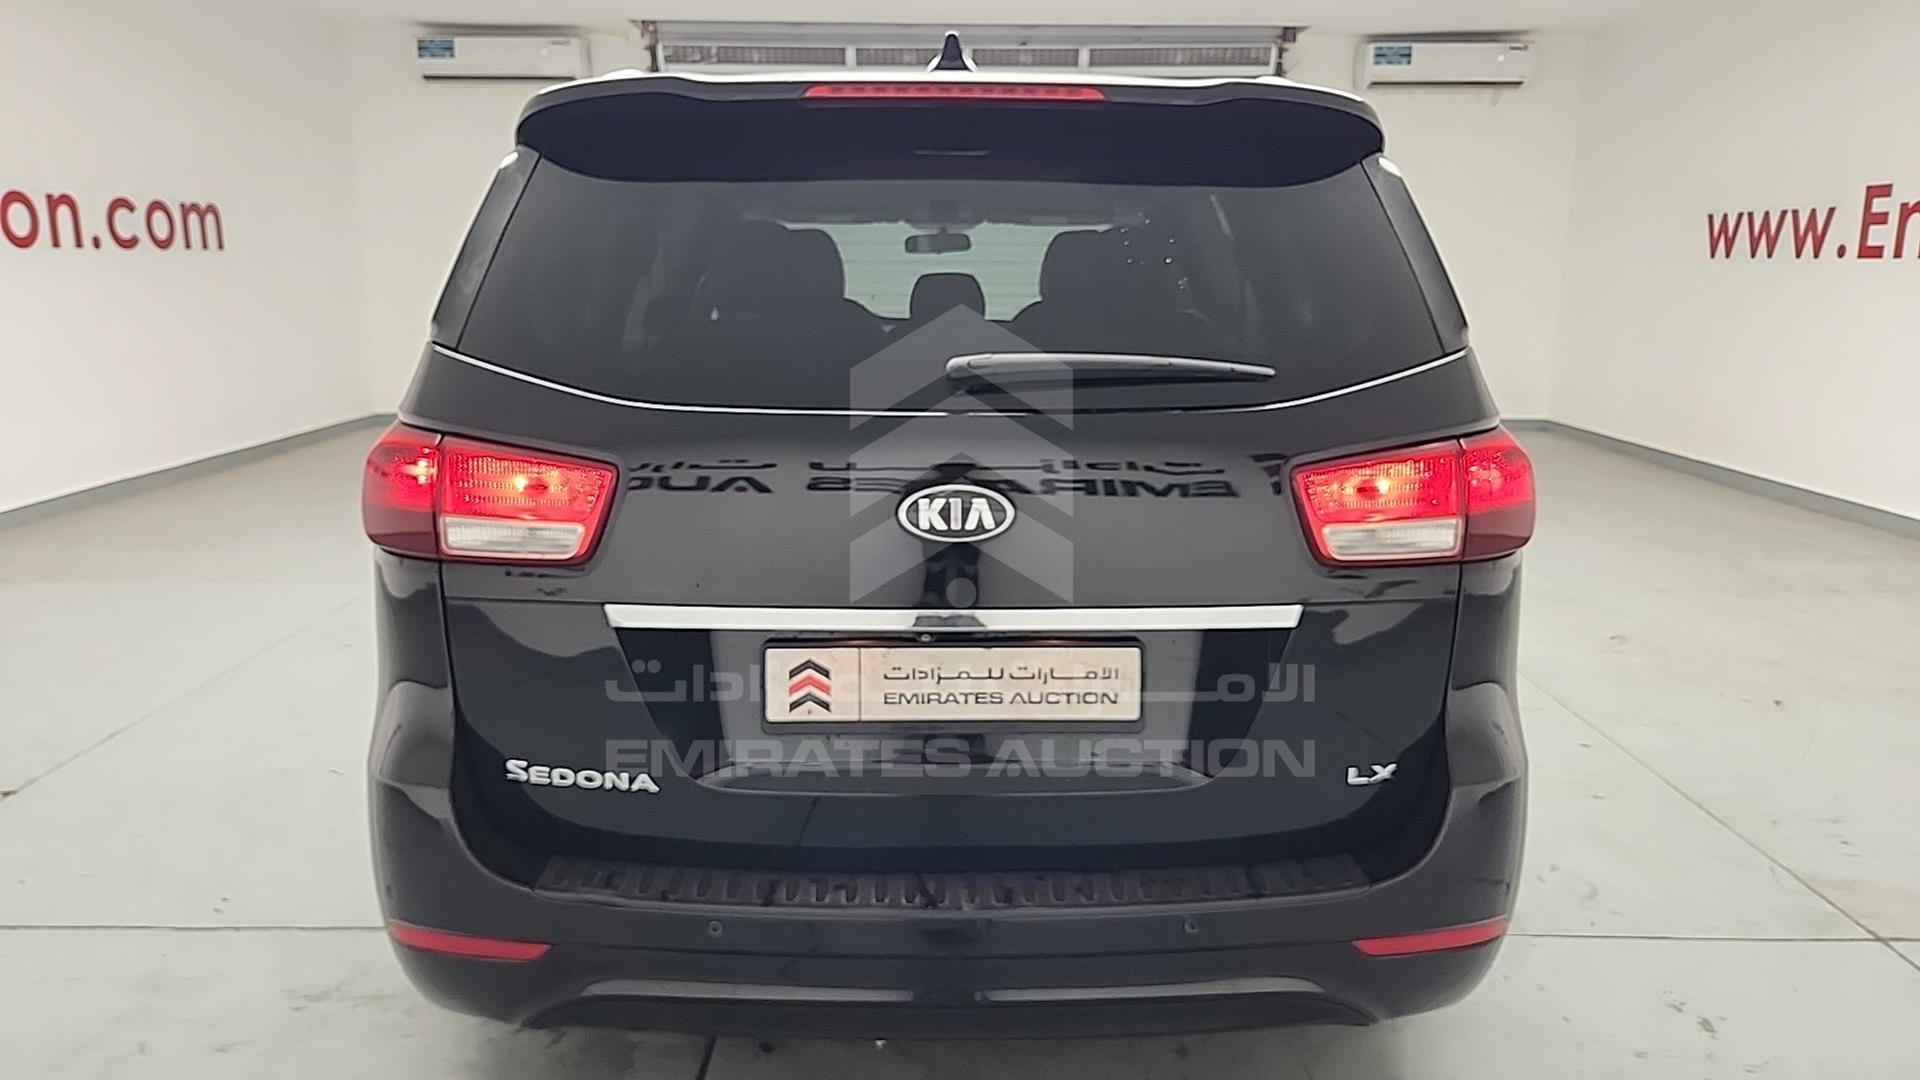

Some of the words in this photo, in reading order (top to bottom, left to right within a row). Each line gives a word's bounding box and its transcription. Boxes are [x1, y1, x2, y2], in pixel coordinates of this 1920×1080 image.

[0, 190, 225, 250] on.com
[917, 497, 996, 531] KIA
[883, 691, 1004, 705] EMIRATES
[1009, 691, 1119, 705] AUCTION
[504, 758, 662, 794] SEDONA
[1346, 763, 1398, 785] LX
